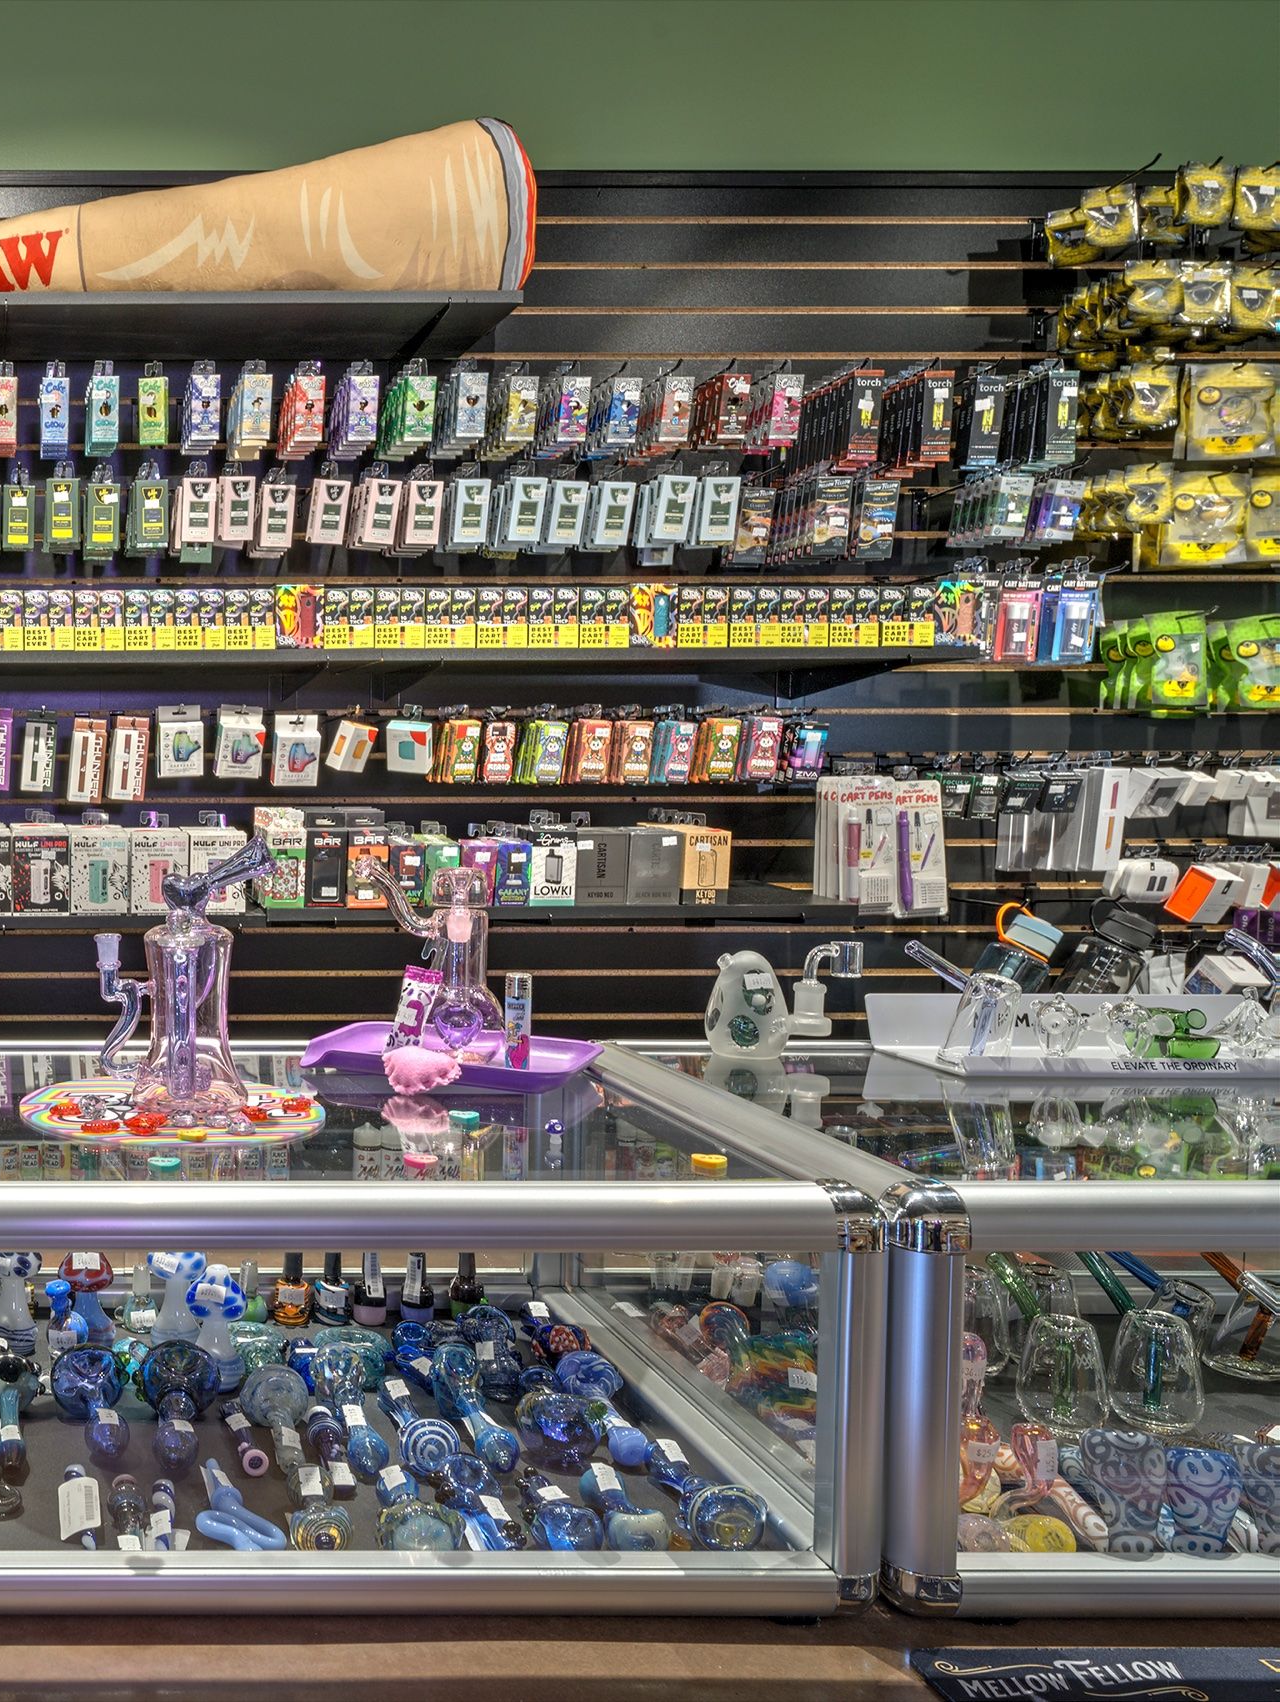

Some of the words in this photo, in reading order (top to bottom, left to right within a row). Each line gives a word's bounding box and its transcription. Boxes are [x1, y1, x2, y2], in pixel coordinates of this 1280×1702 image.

[857, 377, 881, 387] torch
[928, 378, 952, 389] torch
[980, 382, 1004, 393] torch
[1053, 377, 1077, 388] torch
[42, 727, 54, 786] THUNDER
[89, 736, 102, 798] THUNDER
[134, 735, 145, 796] THUNDER
[841, 792, 865, 802] CART
[273, 837, 302, 846] BAR
[314, 837, 341, 846] BAR
[354, 835, 384, 845] BAR
[690, 836, 728, 847] CARTISAN
[597, 842, 608, 880] CARTISAN
[534, 886, 572, 897] LOWKI
[1112, 1061, 1157, 1071] ELEVATE
[1160, 1061, 1180, 1071] THE
[1183, 1061, 1238, 1071] ORDINARY
[957, 1673, 1070, 1698] MELLOW
[1053, 1659, 1183, 1689] FELLOW
